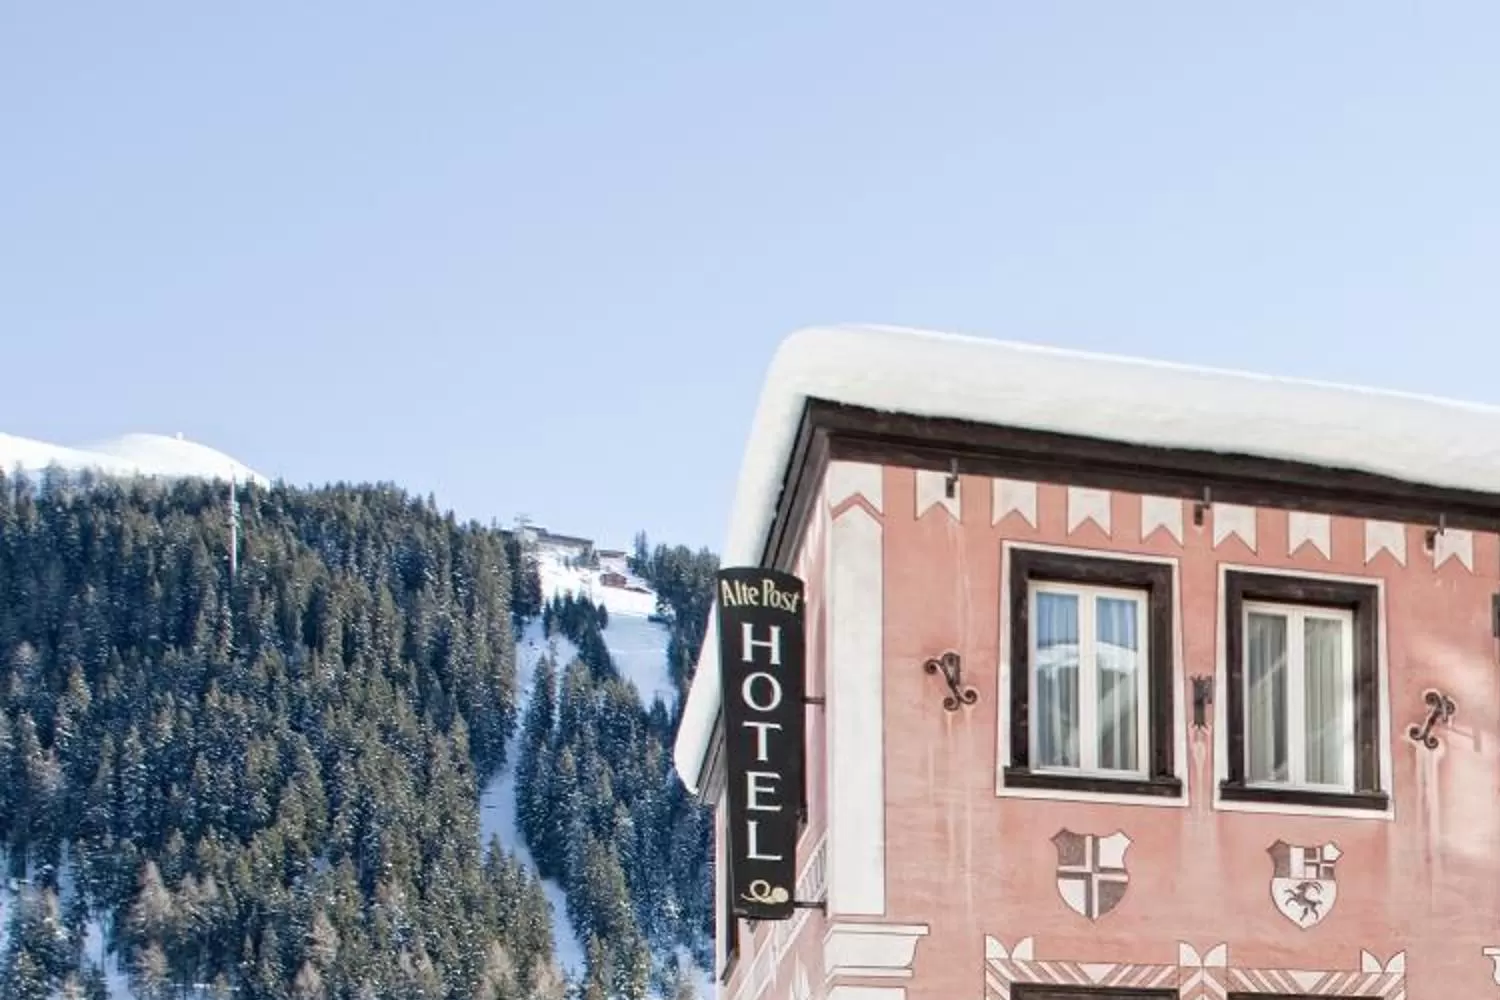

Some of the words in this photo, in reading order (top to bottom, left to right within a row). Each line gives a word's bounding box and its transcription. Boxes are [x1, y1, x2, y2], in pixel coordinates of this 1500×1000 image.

[721, 579, 759, 607] Alte
[761, 579, 800, 614] Post
[740, 621, 784, 861] HOTEL
